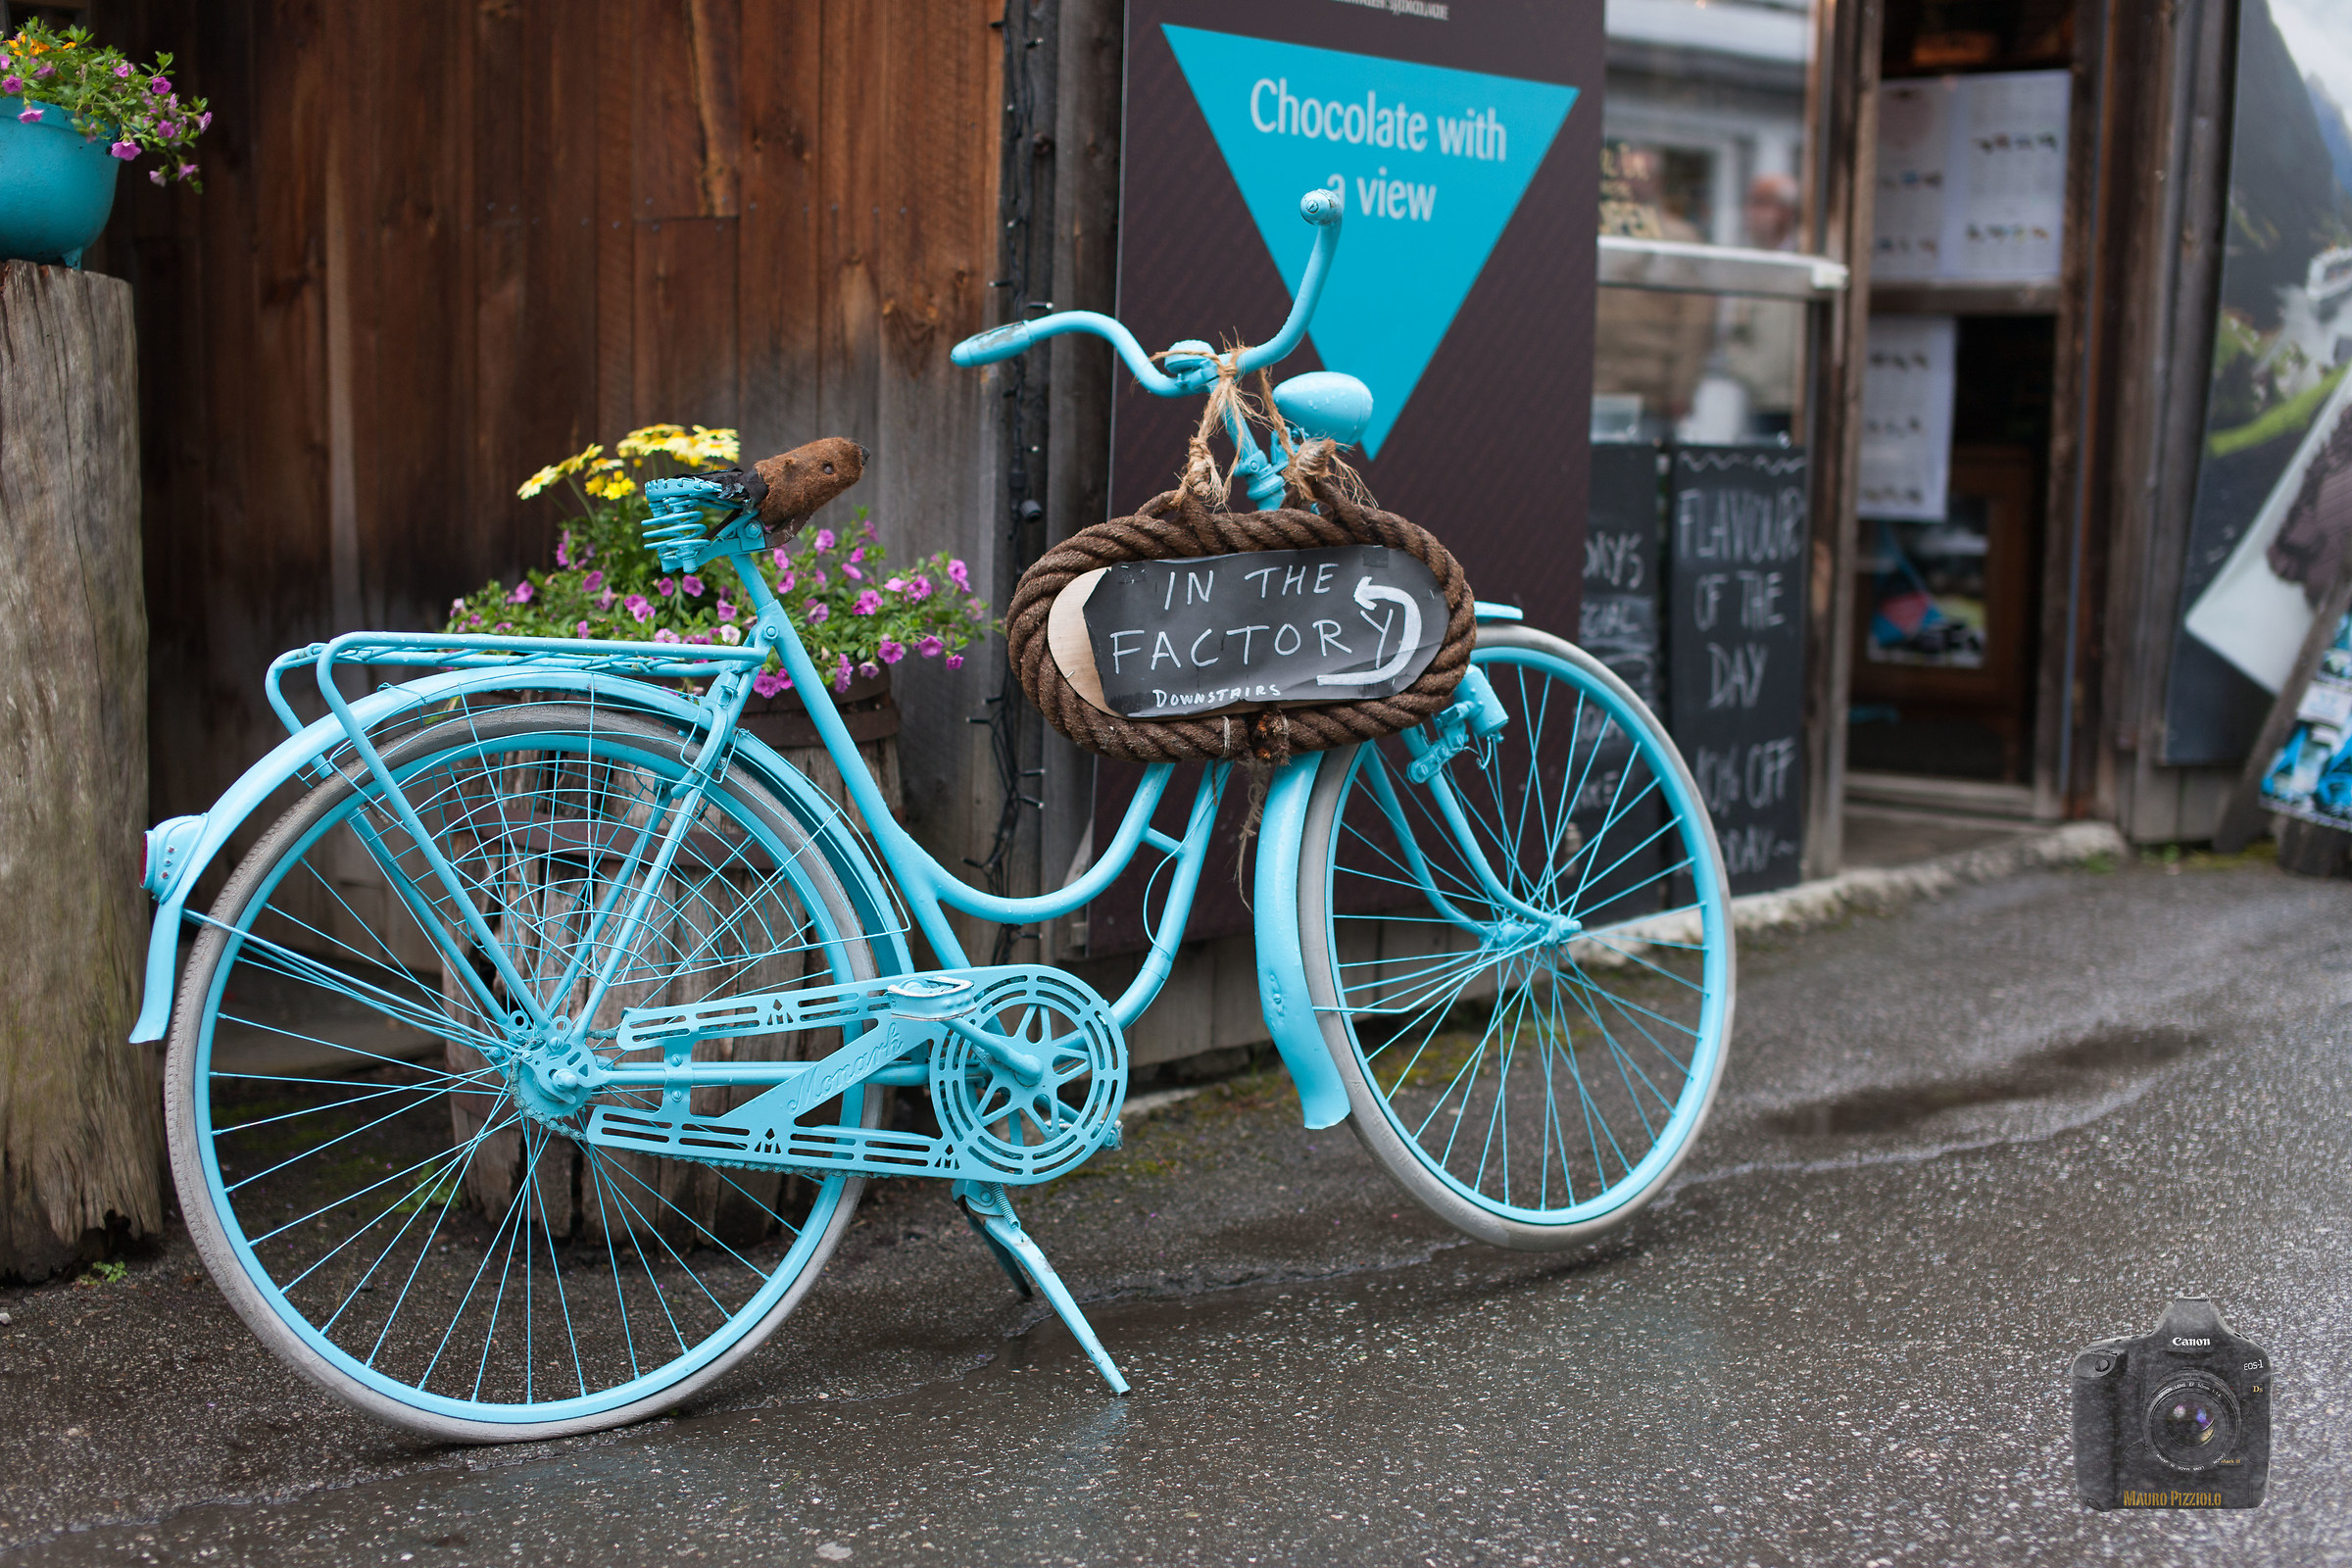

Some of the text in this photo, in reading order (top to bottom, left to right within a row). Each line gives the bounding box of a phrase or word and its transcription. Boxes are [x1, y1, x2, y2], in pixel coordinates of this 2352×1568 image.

[1250, 77, 1507, 162] Chocolate with
[1356, 166, 1437, 222] view
[1164, 563, 1340, 611] IN THE
[1693, 569, 1786, 632] OF THE
[1108, 608, 1394, 676] FACTORY
[1707, 640, 1768, 709] DAY
[1152, 683, 1282, 710] DOWNSTAIRS
[1745, 736, 1795, 809] OFF
[786, 1022, 904, 1115] Monark
